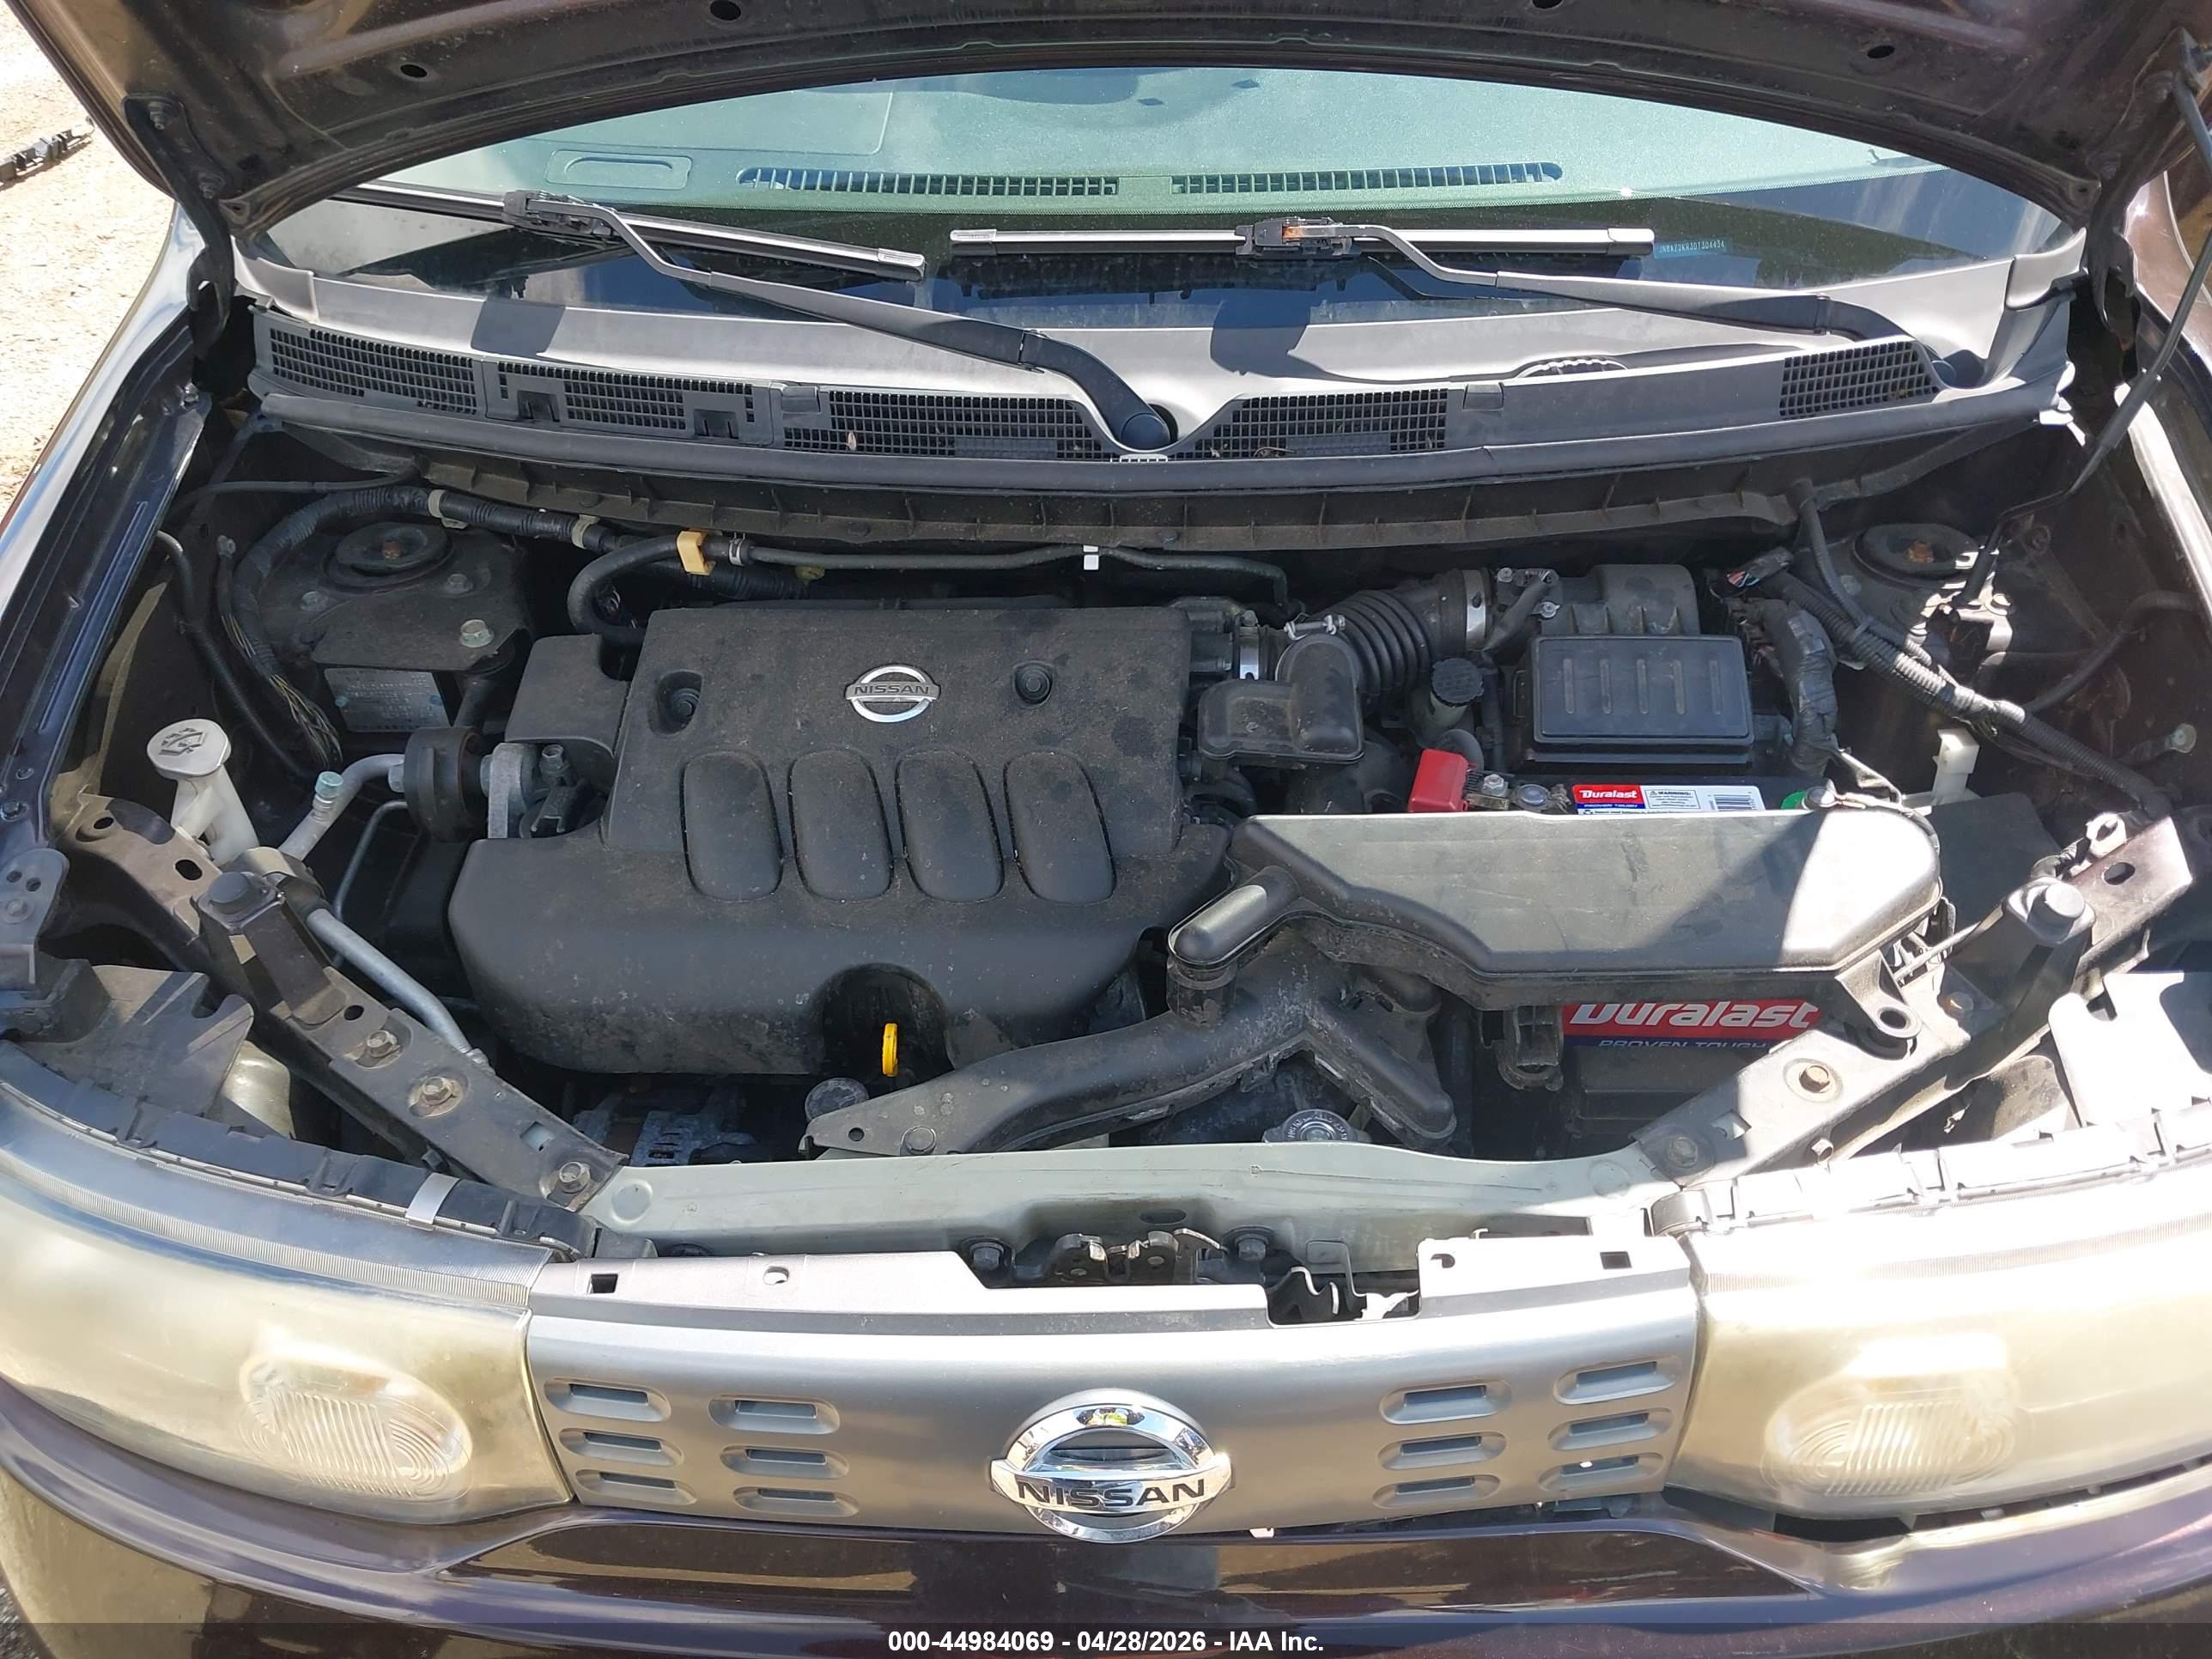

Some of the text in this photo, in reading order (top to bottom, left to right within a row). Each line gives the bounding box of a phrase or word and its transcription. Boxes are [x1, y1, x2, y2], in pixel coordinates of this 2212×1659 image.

[854, 684, 929, 695] NISSAN
[1579, 790, 1638, 799] Duralast
[1015, 1476, 1205, 1508] NISSAN
